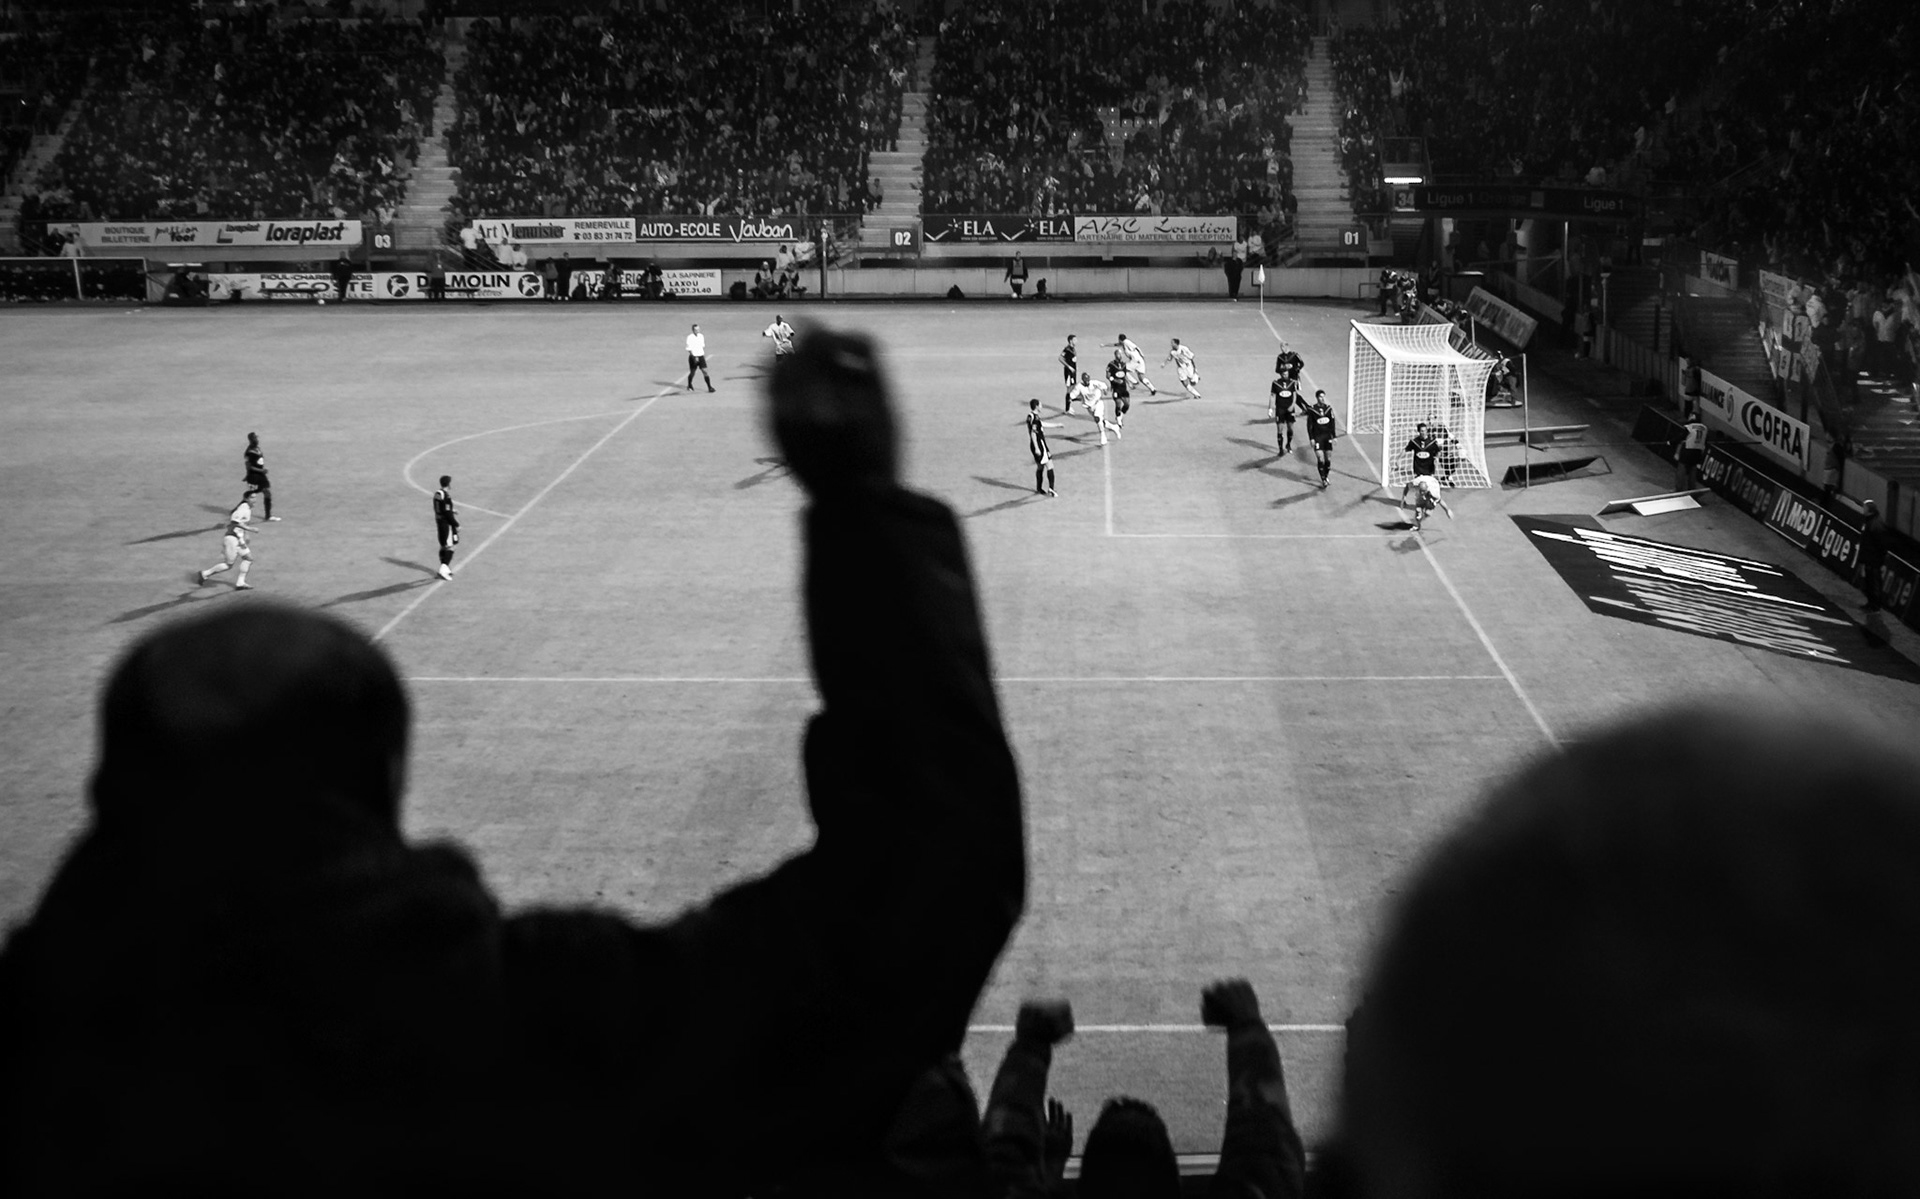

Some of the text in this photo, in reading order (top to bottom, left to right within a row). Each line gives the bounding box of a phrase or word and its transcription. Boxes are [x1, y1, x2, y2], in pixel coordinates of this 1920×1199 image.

[1398, 192, 1415, 206] 34
[1427, 192, 1464, 207] Ligue
[1584, 196, 1615, 212] Ligue
[574, 221, 631, 230] REMEREVILLE
[729, 219, 793, 242] Vauban
[963, 220, 995, 236] ELA
[1039, 220, 1071, 236] ELA
[1077, 217, 1233, 234] ABC Location
[266, 223, 345, 245] loraplast
[375, 235, 391, 248] 03
[894, 231, 912, 246] 02
[1344, 231, 1359, 245] 01
[416, 275, 510, 288] DMOLIN
[1750, 405, 1803, 461] COFRA
[1700, 449, 1725, 481] igue
[1730, 467, 1772, 514] Orange
[1812, 514, 1851, 562] Ligue
